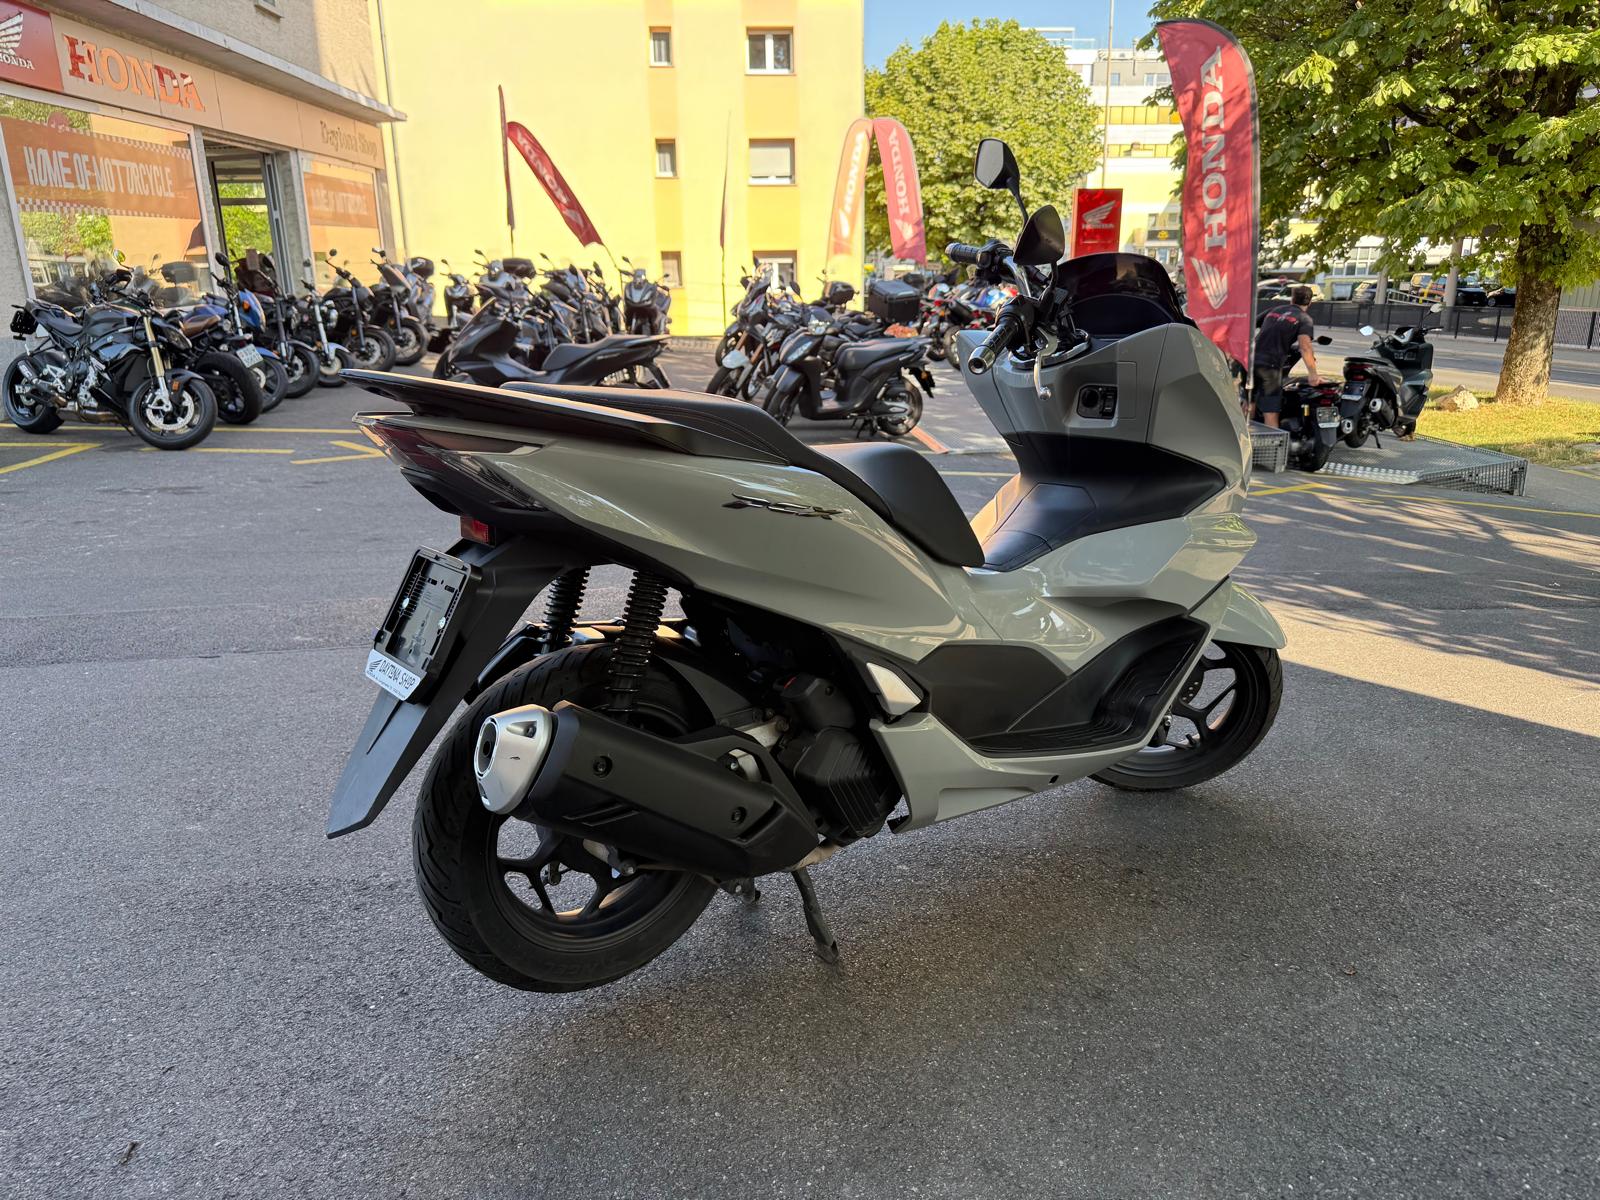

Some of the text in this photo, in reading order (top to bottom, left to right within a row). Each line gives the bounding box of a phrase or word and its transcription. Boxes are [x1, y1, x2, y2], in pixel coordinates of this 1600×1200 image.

[62, 33, 206, 112] HONDA
[23, 146, 75, 188] HOME
[73, 153, 91, 190] OF
[844, 130, 867, 214] HONDA
[888, 127, 910, 216] HONDA
[1200, 46, 1228, 251] HONDA
[399, 672, 416, 690] SHOP
